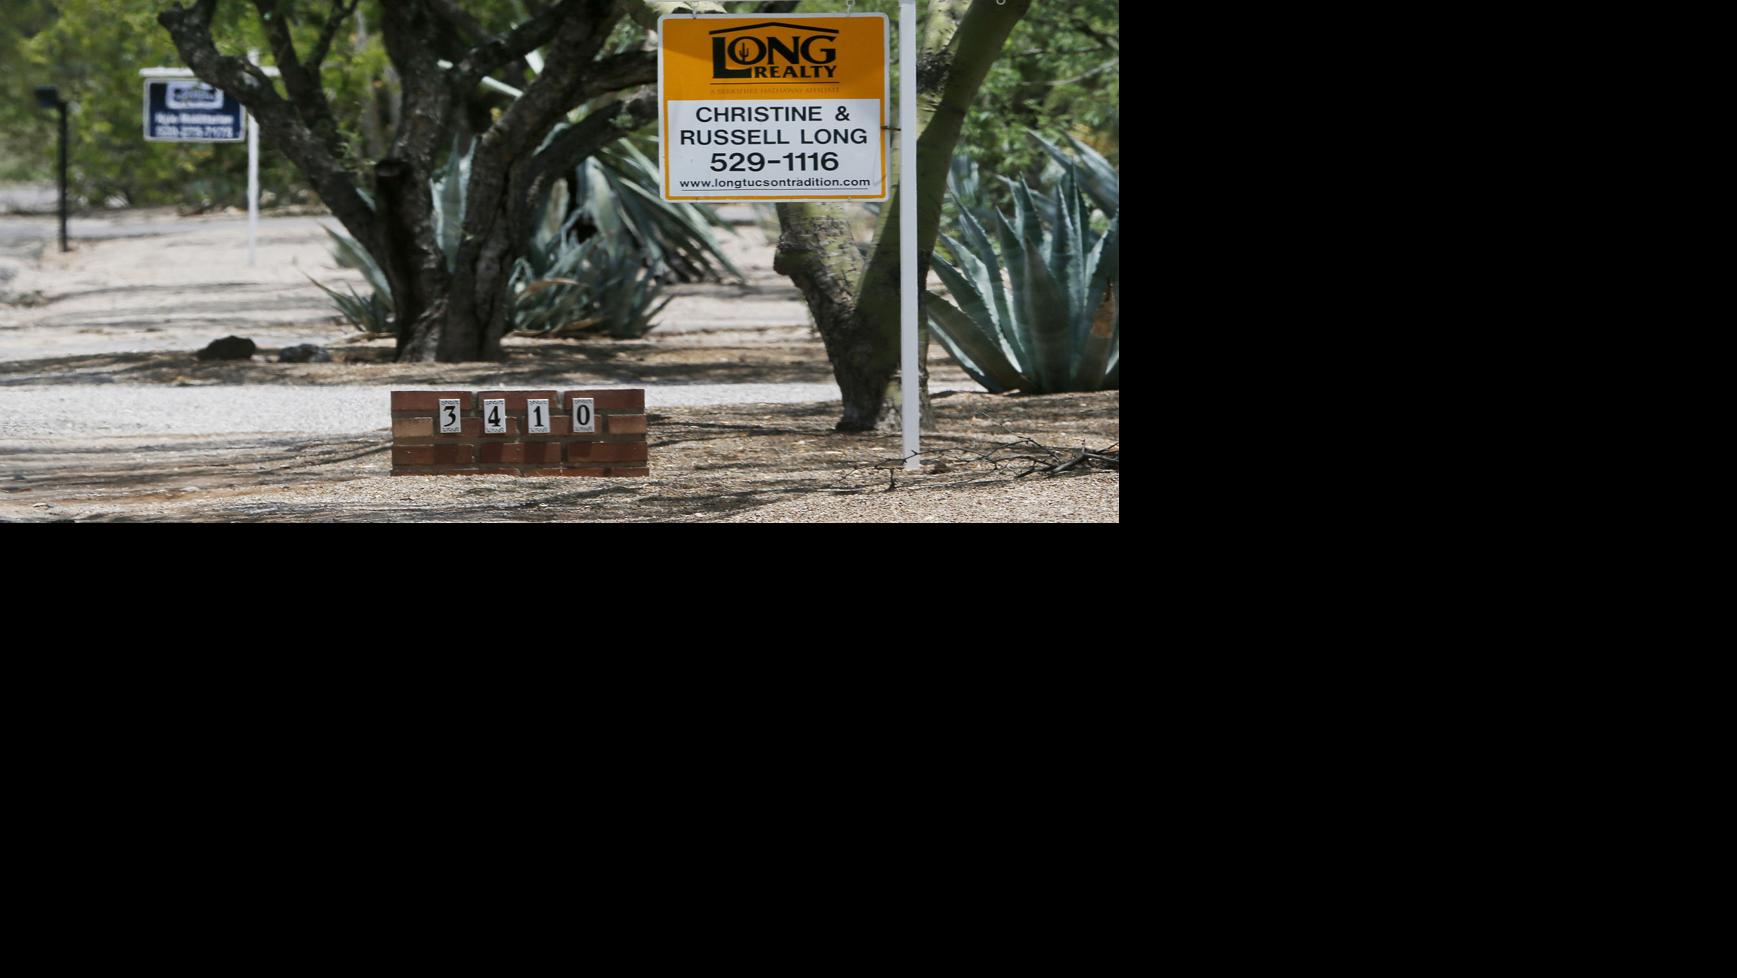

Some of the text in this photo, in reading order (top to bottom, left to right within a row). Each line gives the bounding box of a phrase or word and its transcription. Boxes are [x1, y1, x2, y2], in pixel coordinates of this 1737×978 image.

[712, 35, 837, 79] LONG
[754, 65, 837, 79] REALTY
[695, 105, 850, 123] CHRISTINE &
[680, 128, 867, 145] RUSSELL LONG
[709, 151, 839, 172] 529-1116
[679, 177, 871, 189] www.longtucsontradition.com
